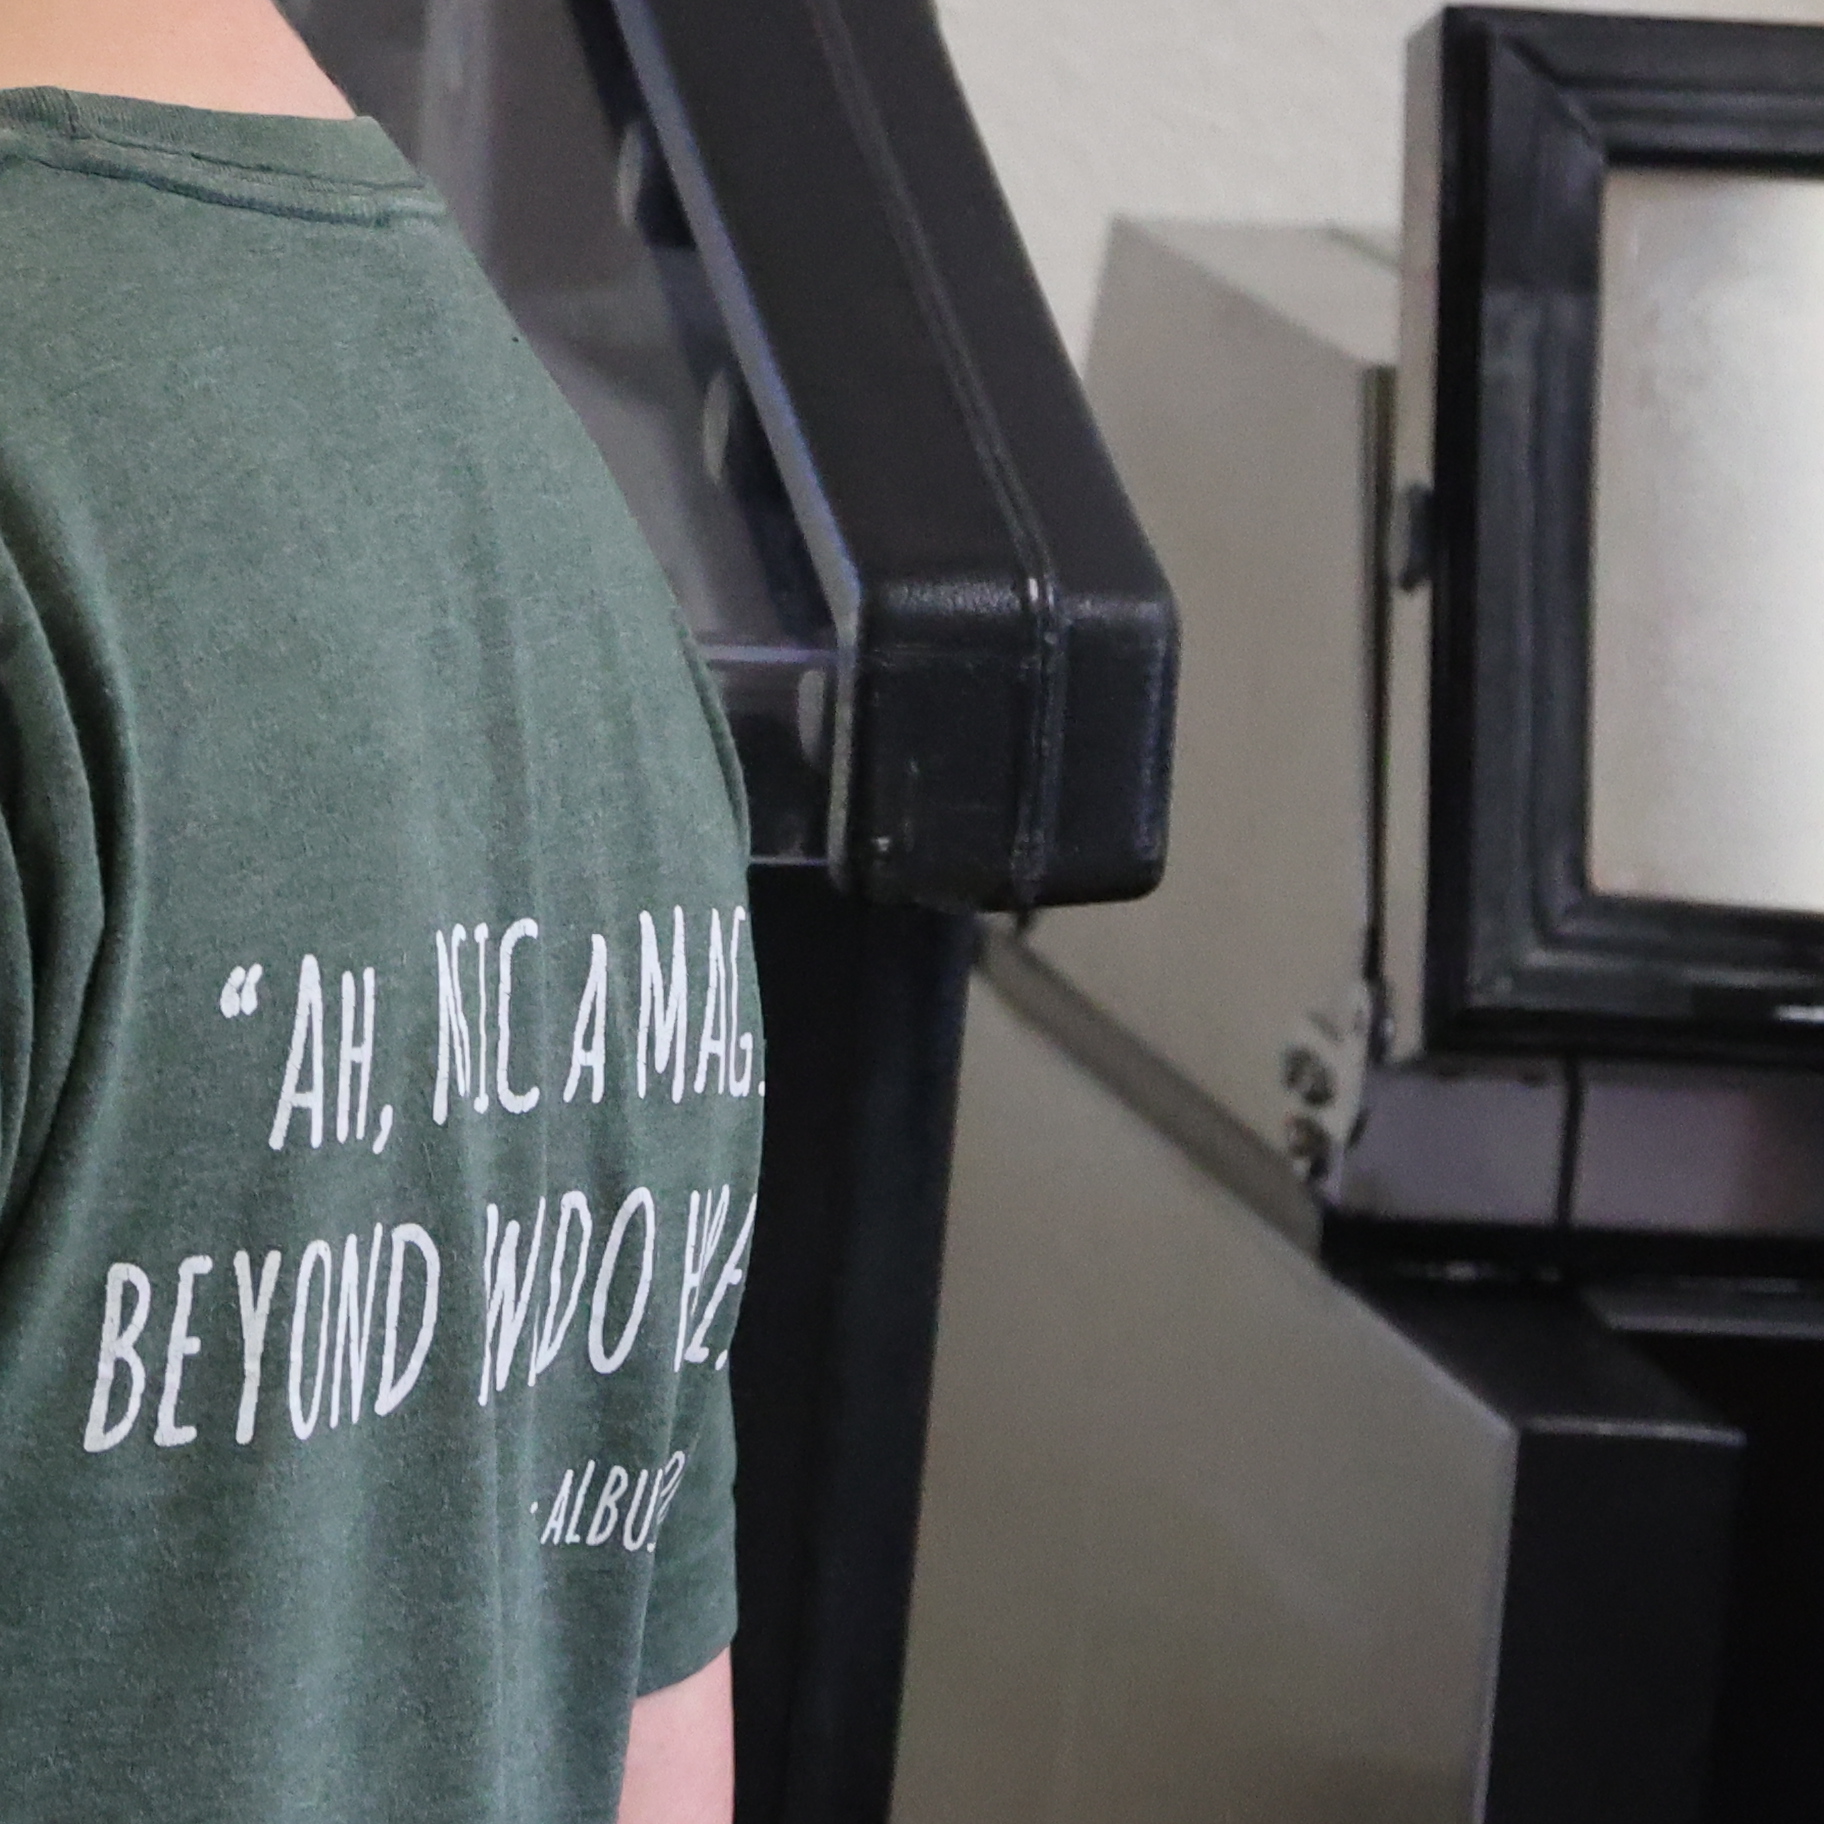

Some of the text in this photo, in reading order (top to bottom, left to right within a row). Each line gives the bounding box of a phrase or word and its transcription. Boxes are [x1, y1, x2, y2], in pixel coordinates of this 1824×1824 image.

[563, 933, 608, 1104] A
[637, 904, 766, 1104] MAG
[83, 1222, 441, 1453] BEYOND
